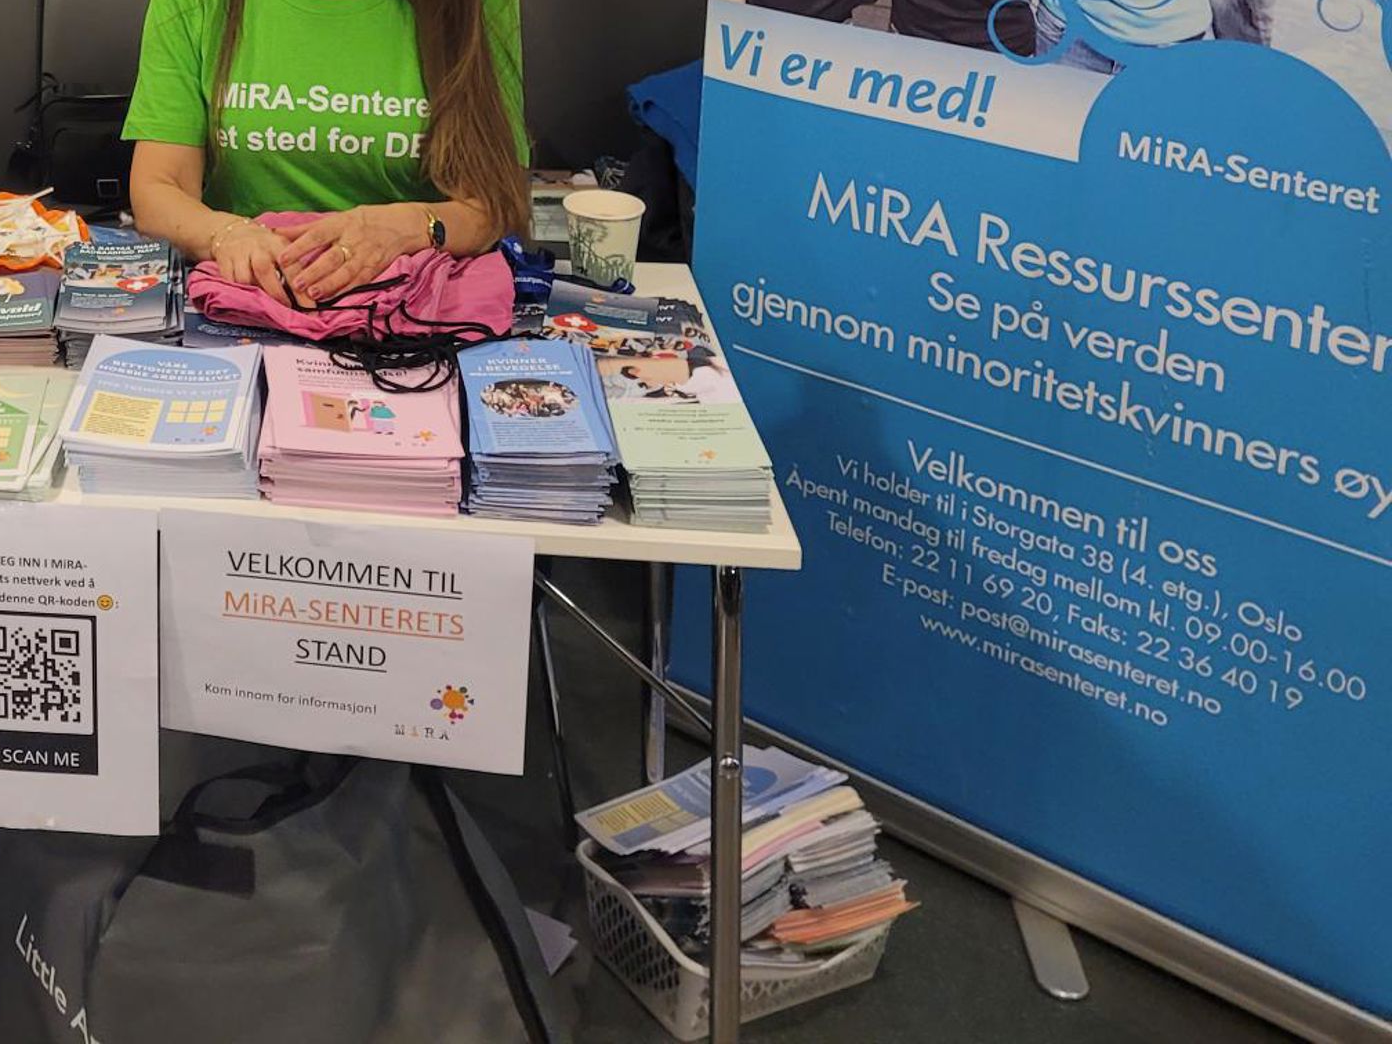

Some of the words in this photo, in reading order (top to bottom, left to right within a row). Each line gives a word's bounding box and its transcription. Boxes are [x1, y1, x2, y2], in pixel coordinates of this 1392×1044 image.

[719, 22, 766, 78] Vi
[779, 50, 833, 92] er
[848, 63, 997, 129] med!
[222, 82, 432, 118] MiRA-Sentere
[216, 126, 240, 148] et
[246, 126, 317, 152] sted
[326, 127, 375, 155] for
[384, 131, 422, 159] DE
[1118, 131, 1381, 214] MiRA-Senteret
[807, 171, 960, 257] MiRA
[975, 211, 1392, 372] Ressurssenter
[0, 302, 42, 315] vold
[927, 271, 982, 322] Se
[991, 299, 1052, 345] på
[1061, 322, 1226, 393] verden
[485, 364, 561, 372] BEVEGELSE
[487, 357, 548, 365] KVINNER
[732, 277, 895, 352] gjennom
[907, 332, 1320, 489] minoritetskvinners
[1333, 460, 1392, 522] øy
[907, 438, 1106, 538] Velkommen
[1115, 514, 1149, 553] til
[1158, 537, 1219, 578] oss
[17, 556, 41, 569] INN
[50, 558, 88, 571] MiRA-
[226, 549, 413, 590] VELKOMMEN
[422, 568, 464, 595] TIL
[836, 454, 858, 480] Vi
[860, 461, 931, 510] holder
[934, 490, 957, 516] til
[960, 497, 969, 522] i
[971, 504, 1077, 568] Storgata
[1082, 541, 1115, 575] 38
[1119, 556, 1155, 591] (4.
[1159, 572, 1230, 622] etg.),
[1236, 601, 1304, 644] Oslo
[12, 574, 61, 588] nettverk
[64, 576, 86, 589] ved
[87, 576, 96, 589] å
[37, 593, 96, 609] QR-koden
[785, 467, 849, 512] Åpent
[853, 492, 942, 547] mandag
[945, 524, 968, 551] til
[971, 534, 1048, 588] fredag
[1052, 568, 1143, 618] mellom
[1148, 600, 1178, 631] kl.
[1183, 616, 1367, 702] 09.00-16.00
[222, 589, 465, 636] MiRA-SENTERETS
[825, 509, 905, 561] Telefon:
[910, 542, 939, 572] 22
[947, 556, 974, 587] 11
[981, 567, 1015, 599] 69
[1021, 586, 1062, 621] 20,
[1067, 602, 1129, 647] Faks:
[1137, 629, 1169, 665] 22
[1176, 644, 1212, 679] 36
[1220, 660, 1257, 695] 40
[1268, 679, 1304, 712] 19
[294, 636, 387, 668] STAND
[882, 561, 956, 616] E-post:
[960, 598, 1223, 718] post@mirasenteret.no
[919, 612, 1169, 727] www.mirasenteret.no
[204, 682, 231, 696] Kom
[234, 687, 275, 701] innom
[277, 690, 295, 705] for
[298, 692, 378, 717] informasjon!
[2, 747, 53, 767] SCAN
[57, 749, 81, 768] ME
[14, 912, 68, 1016] Little
[70, 1007, 101, 1044] A
